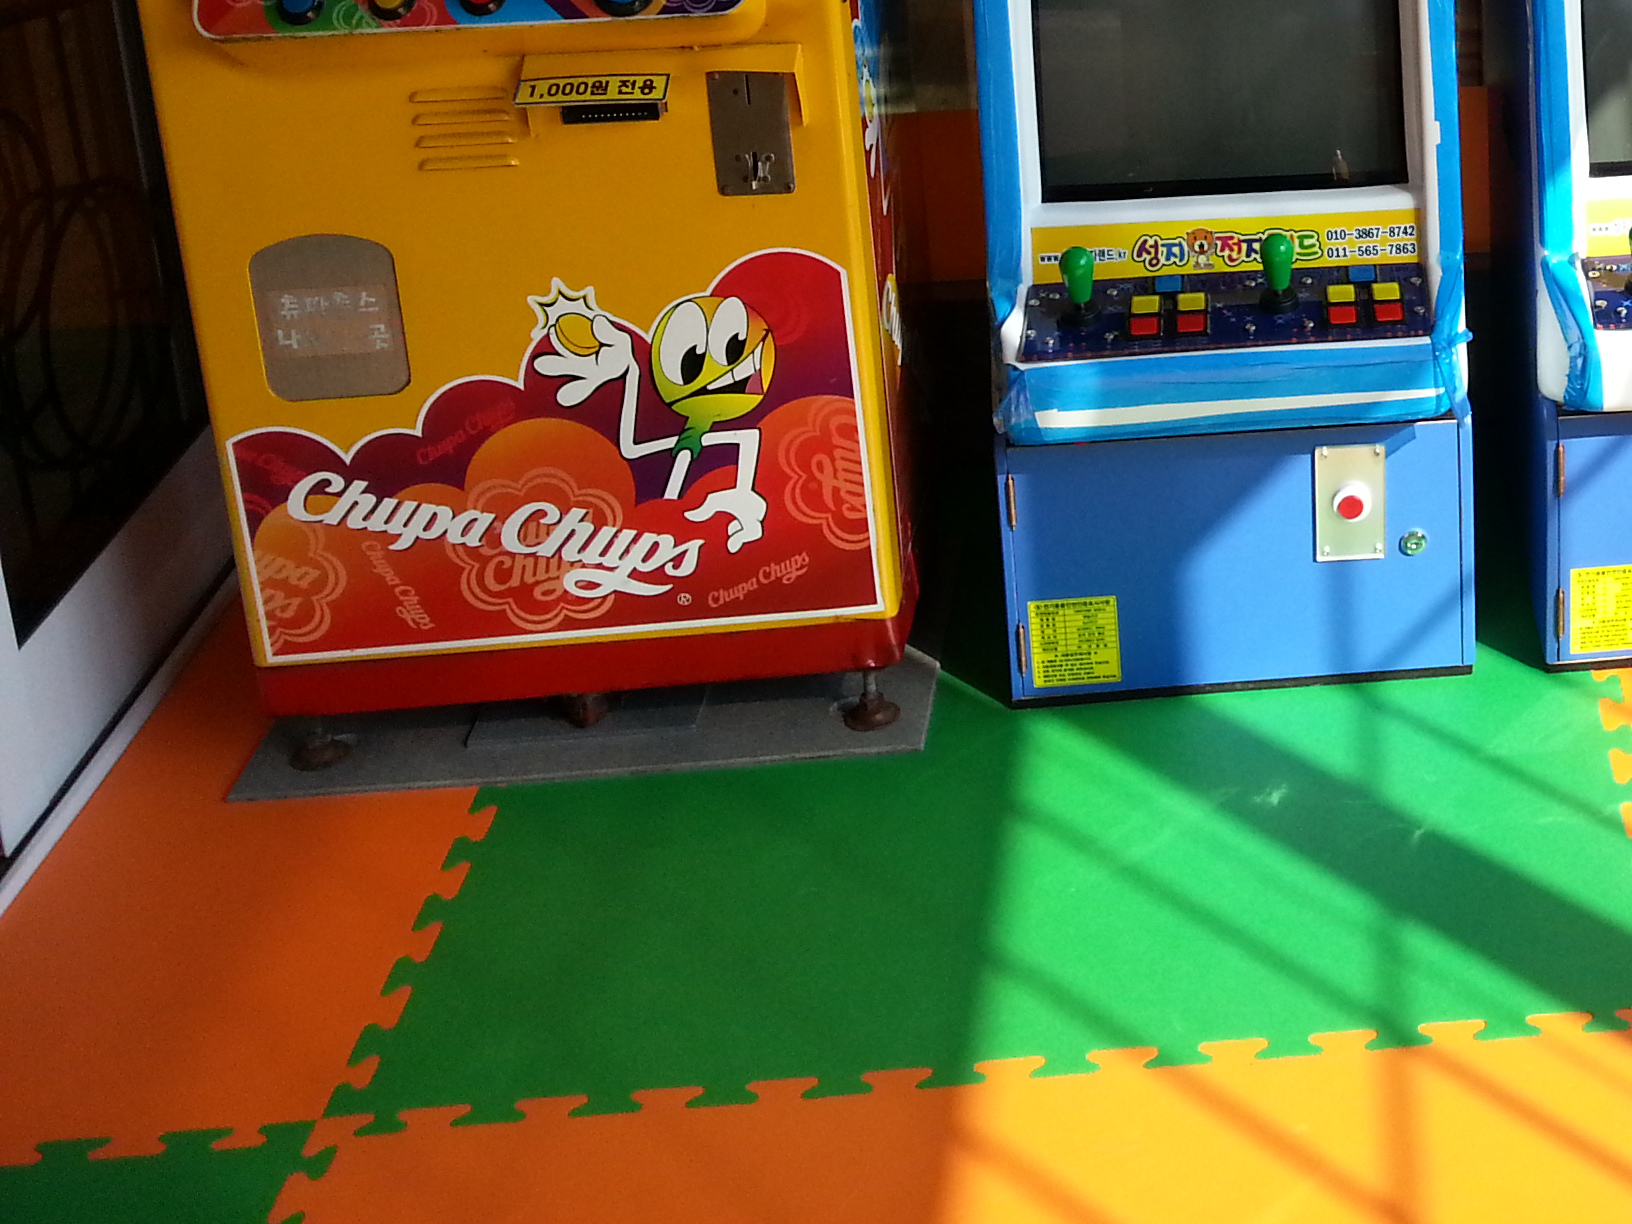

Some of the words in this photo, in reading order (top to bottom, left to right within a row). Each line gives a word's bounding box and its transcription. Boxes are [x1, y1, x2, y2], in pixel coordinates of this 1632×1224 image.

[528, 80, 609, 99] 1,000원
[617, 78, 657, 96] 전용
[1326, 225, 1415, 241] 010-3867-8742
[1136, 237, 1187, 269] 성지
[1327, 242, 1416, 259] 011-565-7863
[286, 471, 497, 551] Chupa
[501, 501, 705, 598] Chups
[361, 540, 402, 593] Chupa
[708, 576, 758, 608] Chupa
[758, 551, 810, 584] Chups
